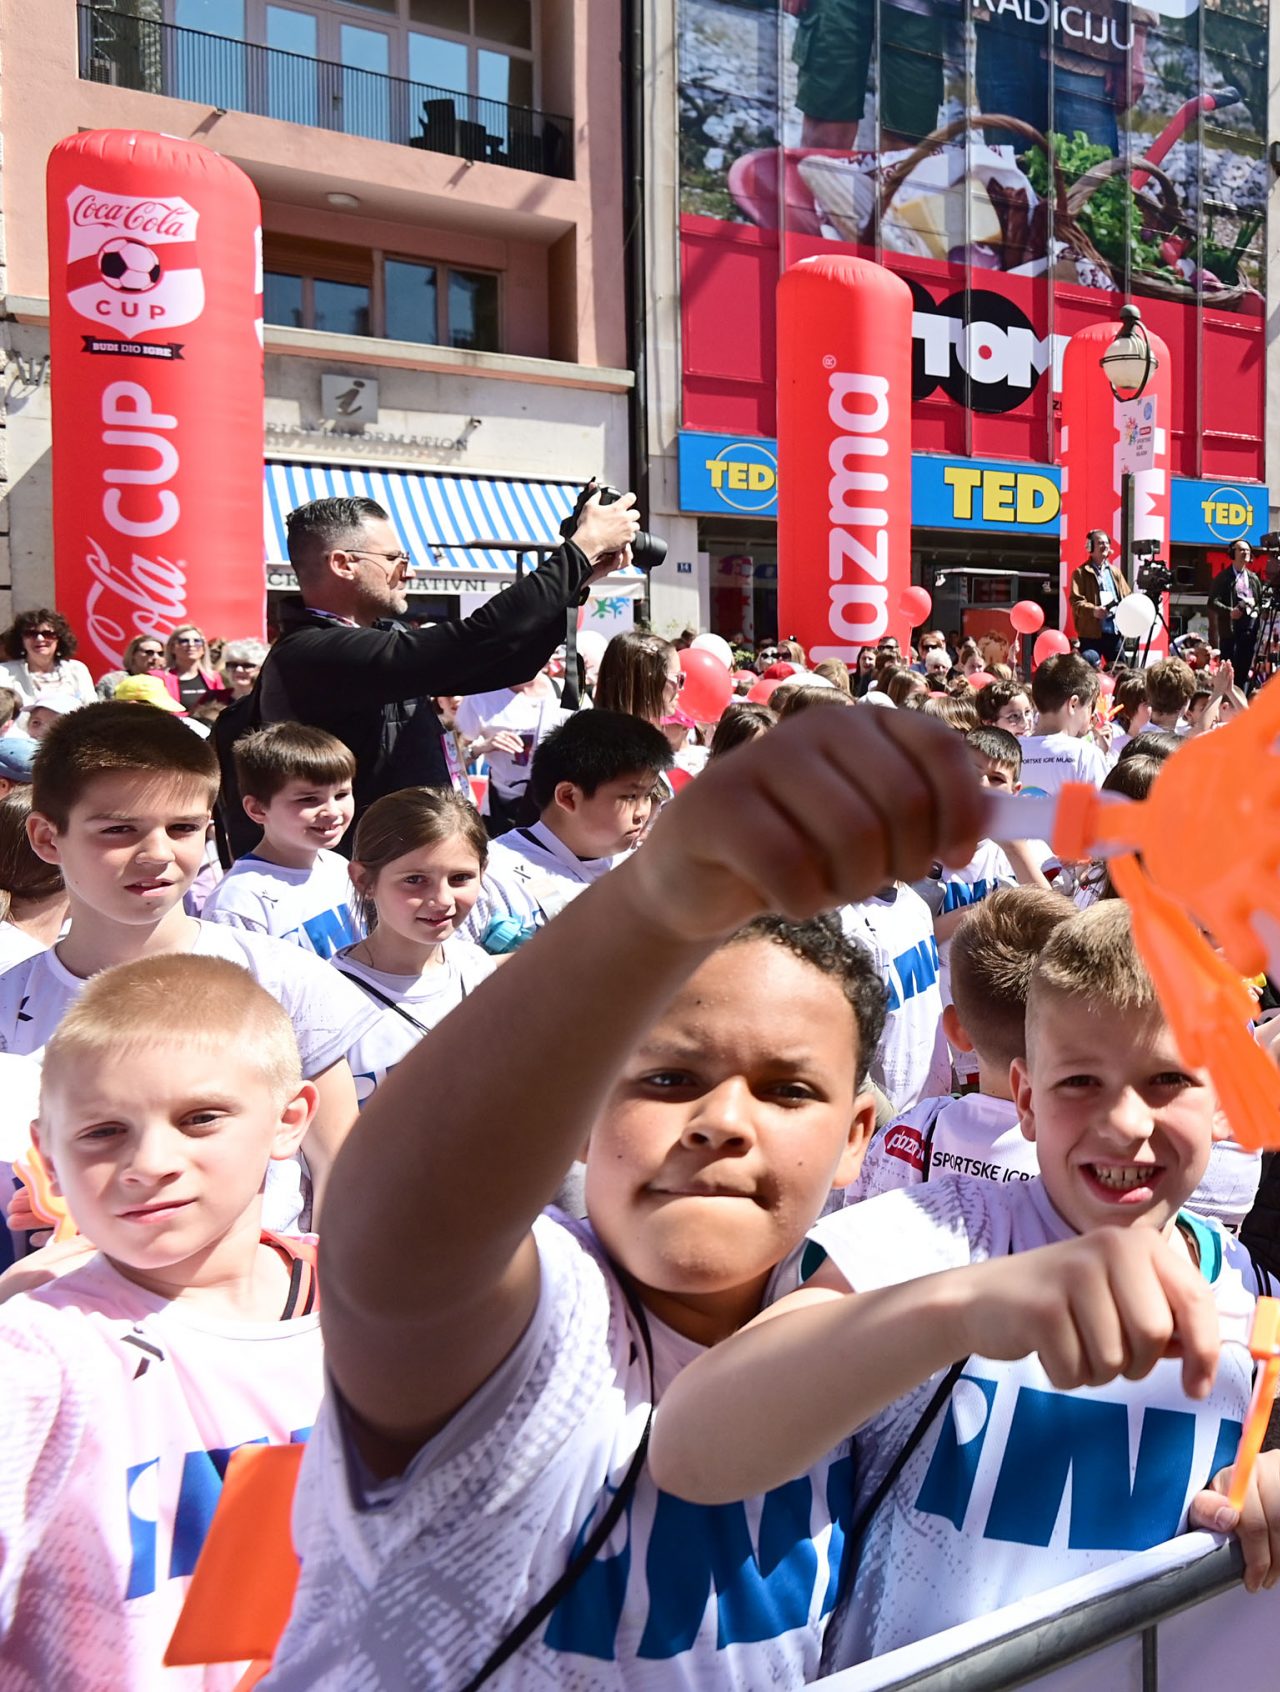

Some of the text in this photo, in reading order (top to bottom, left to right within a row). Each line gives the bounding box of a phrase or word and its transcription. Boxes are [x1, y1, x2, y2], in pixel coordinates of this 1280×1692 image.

[73, 194, 190, 237] Coca-Cola
[96, 300, 166, 320] CUP
[92, 342, 119, 351] BUDI
[102, 380, 180, 537] CUP
[705, 459, 778, 492] TED
[1201, 500, 1254, 527] TEDi
[932, 1151, 1002, 1181] SPORTSKE
